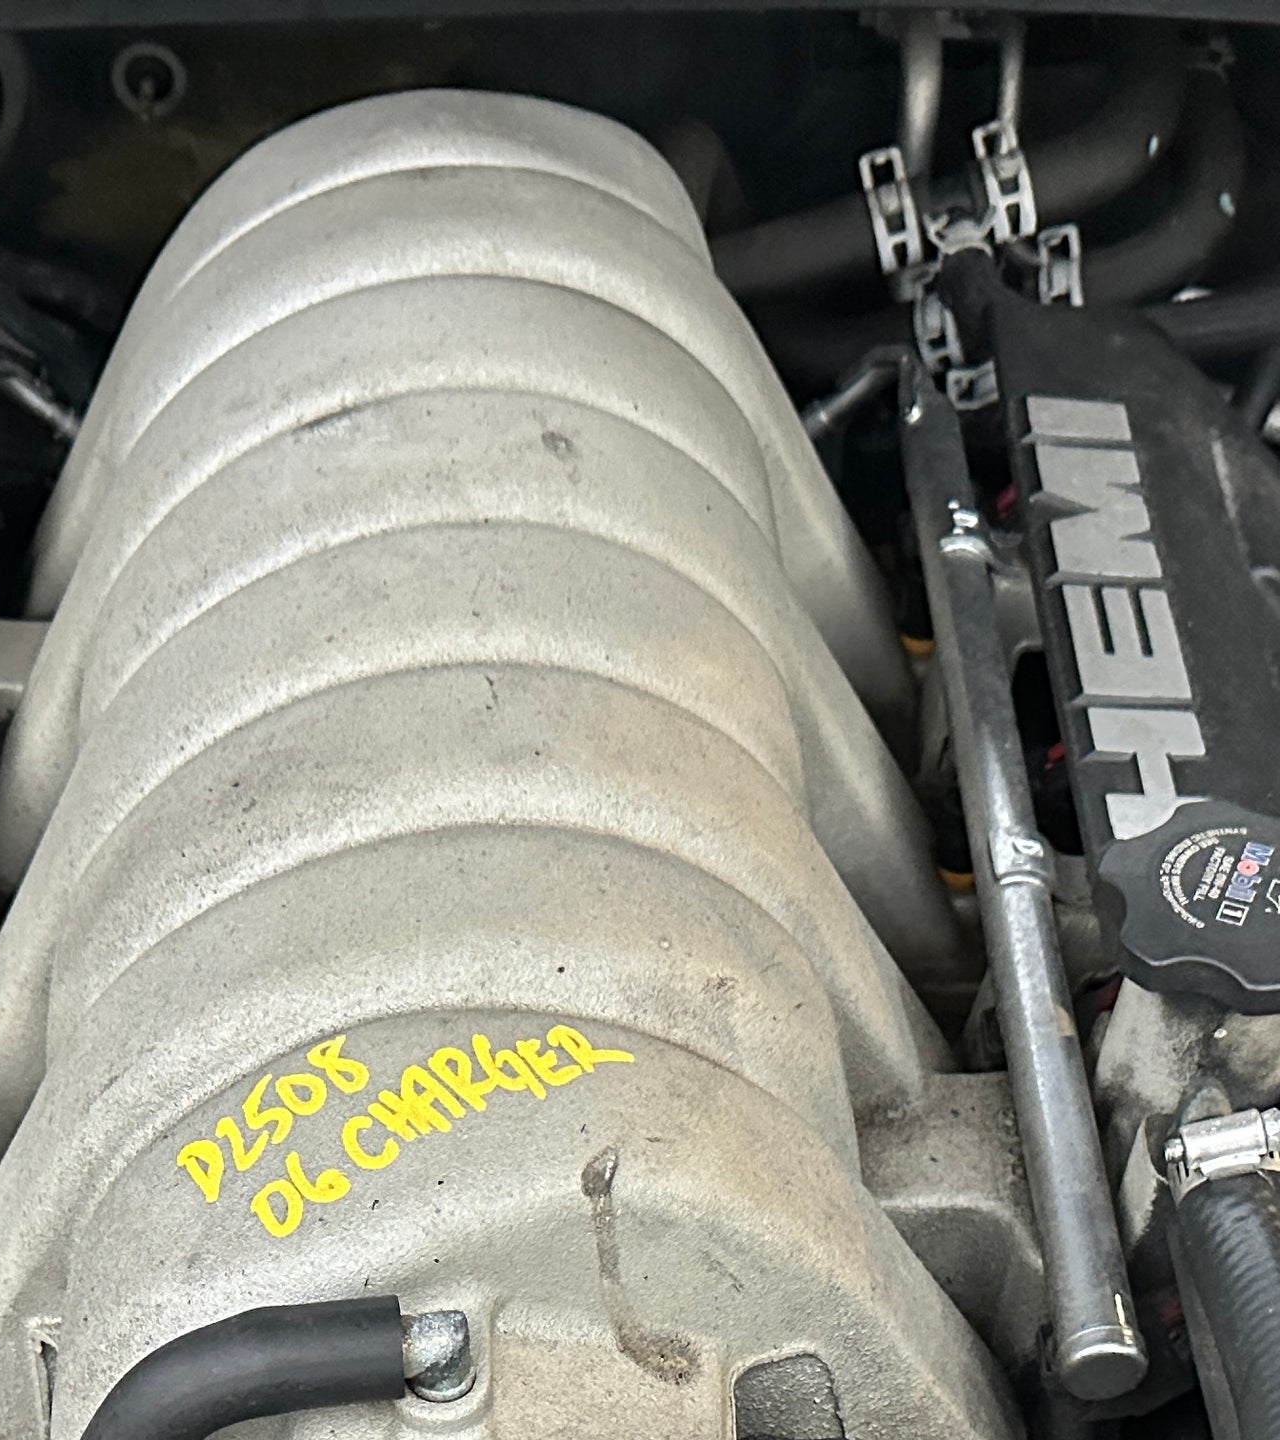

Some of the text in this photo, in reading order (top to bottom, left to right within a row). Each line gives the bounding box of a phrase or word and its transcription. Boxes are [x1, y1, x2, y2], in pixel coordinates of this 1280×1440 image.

[1026, 395, 1209, 841] HEMI
[1219, 855, 1235, 874] SAE
[1225, 841, 1276, 902] Mobil
[176, 1034, 370, 1204] D2508
[250, 1024, 636, 1238] 06 CHARGER
